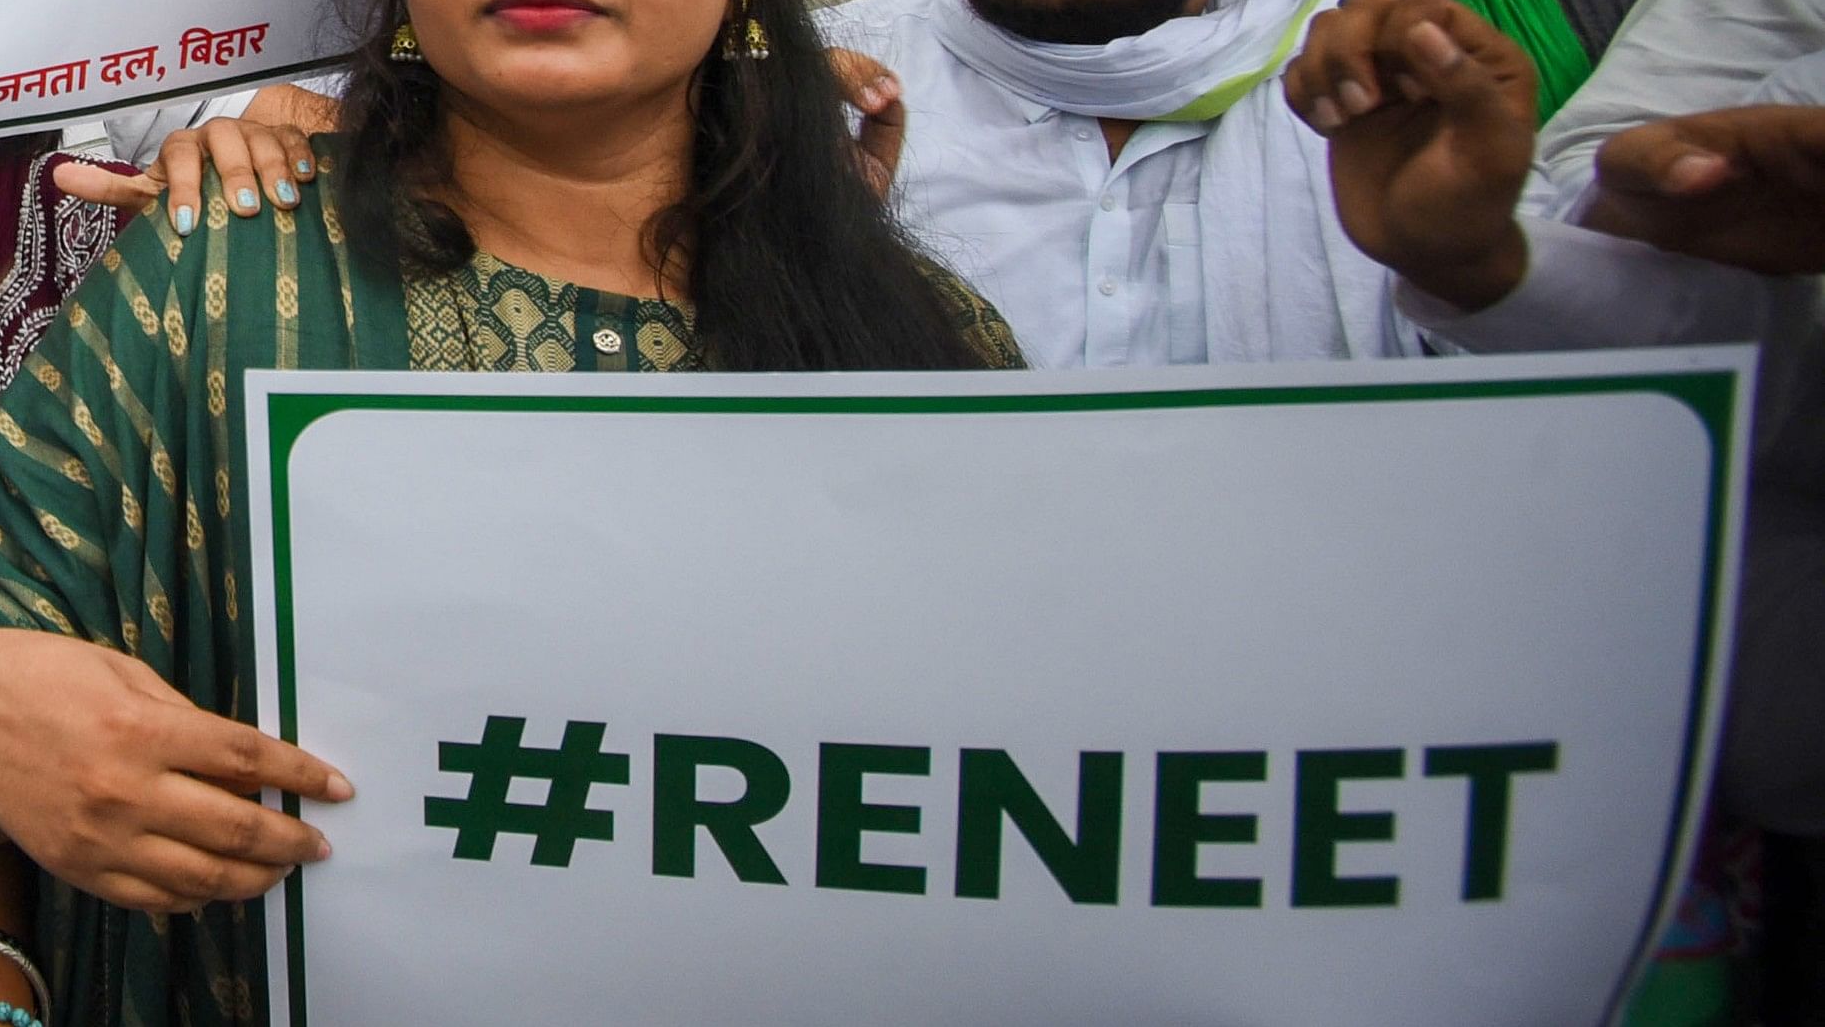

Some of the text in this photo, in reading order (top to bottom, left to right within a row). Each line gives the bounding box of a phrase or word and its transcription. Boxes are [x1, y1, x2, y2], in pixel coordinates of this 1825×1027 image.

[100, 45, 166, 86] दल,
[179, 23, 270, 70] बिहार
[424, 714, 1560, 911] #RENEET
